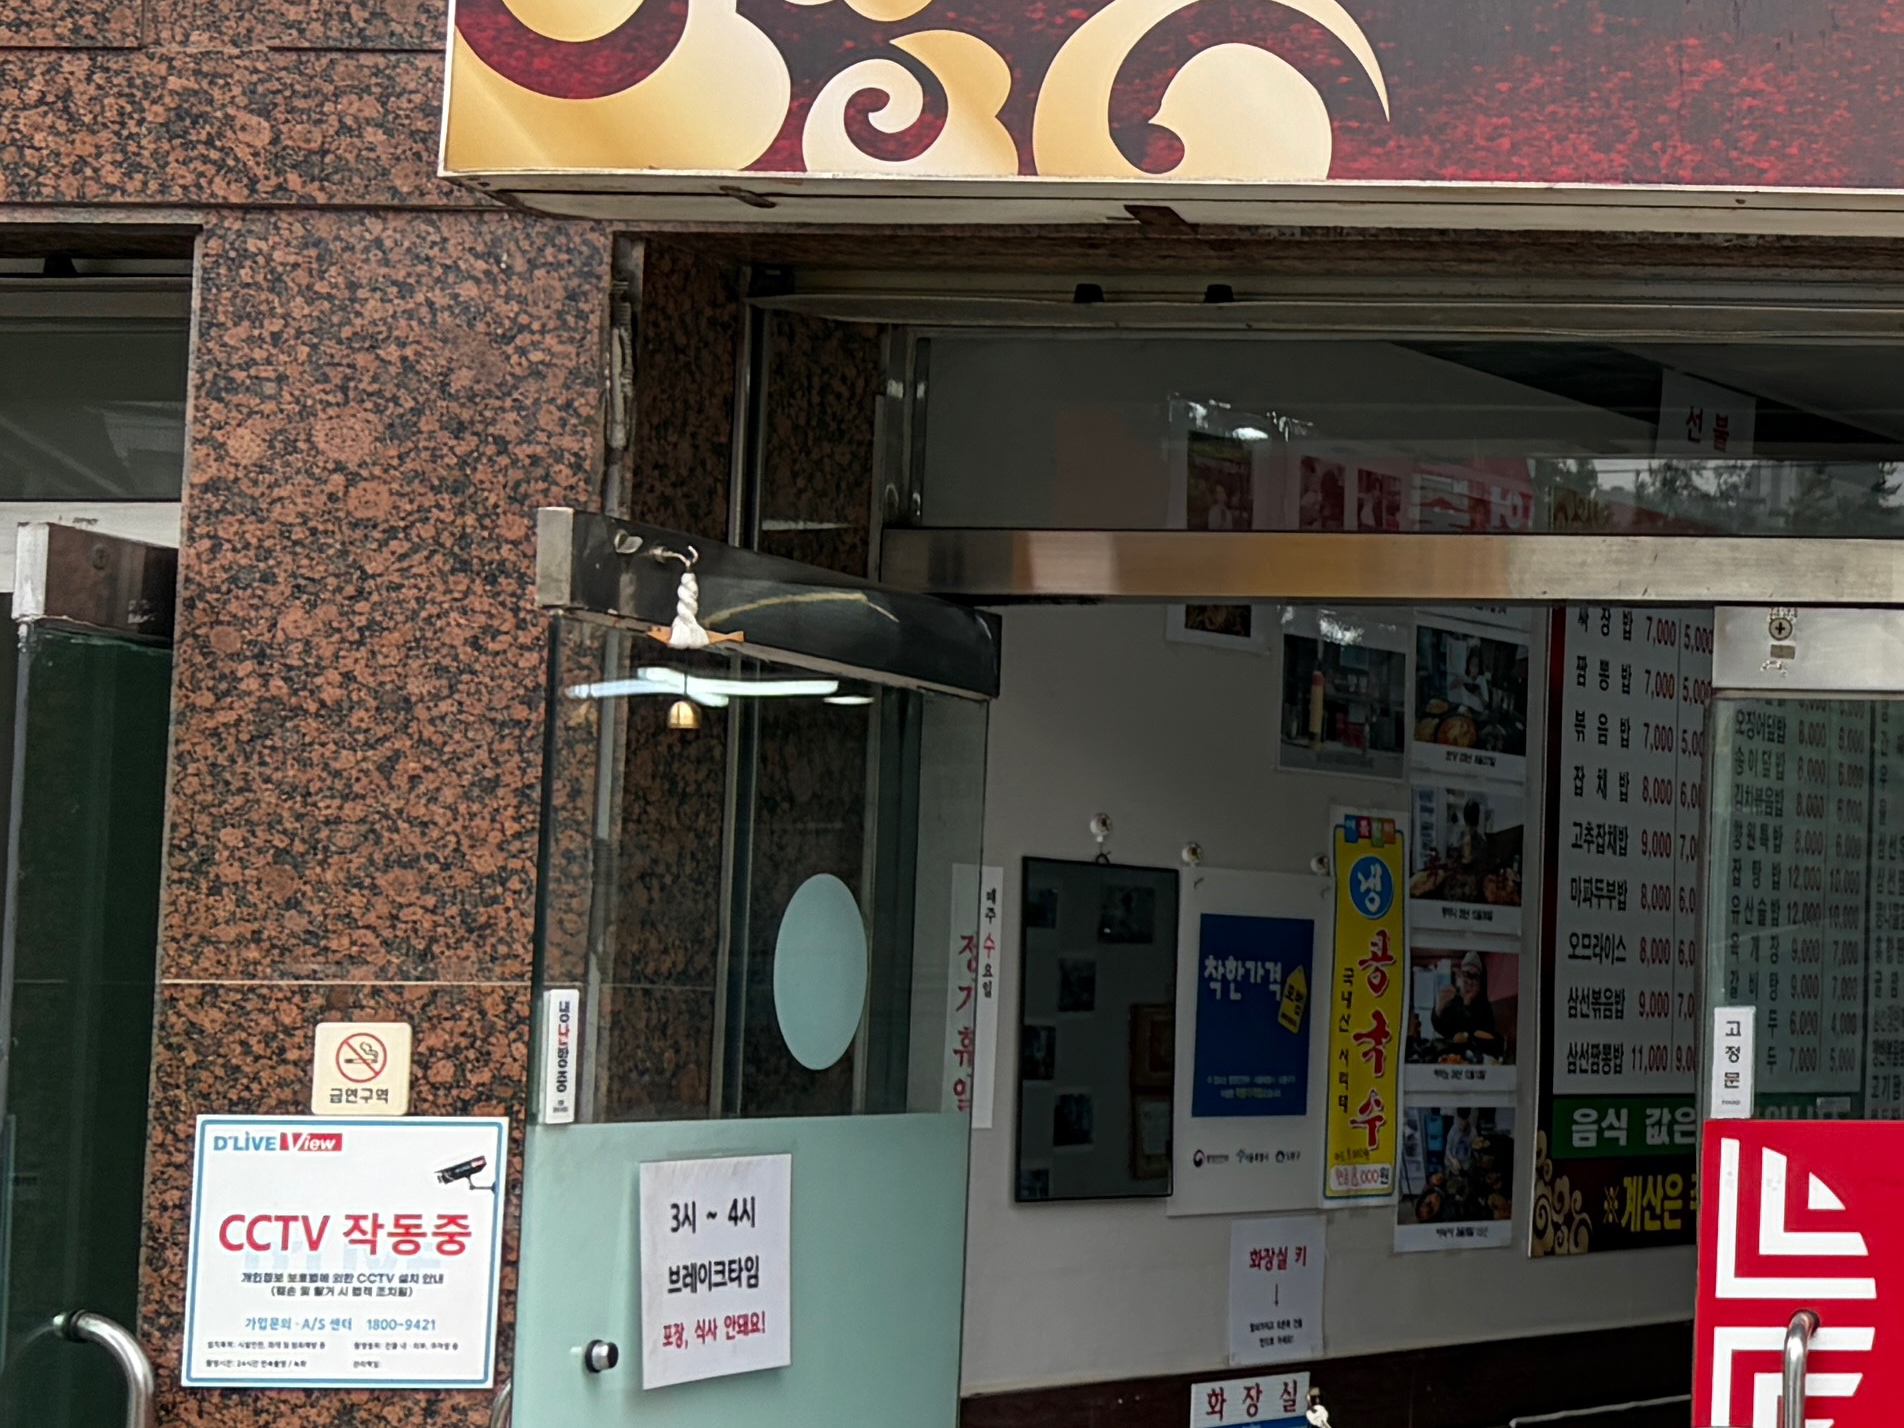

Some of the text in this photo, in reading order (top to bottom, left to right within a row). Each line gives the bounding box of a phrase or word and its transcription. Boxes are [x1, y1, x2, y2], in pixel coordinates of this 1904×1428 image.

[1646, 616, 1677, 647] 7,000
[1644, 670, 1675, 700] 7,000
[1643, 722, 1674, 753] 7,000
[1642, 775, 1673, 806] 8,000
[1571, 821, 1672, 860] 고추잡채밥 9,000
[1570, 875, 1671, 913] 마파두부밥 8,000
[1568, 931, 1671, 967] 오므라이스 8,000
[1203, 954, 1283, 1002] 착한가격
[1567, 986, 1670, 1021] 삼선볶음밥 9,000
[1566, 1041, 1669, 1076] 삼선짬뽕밥 11,000
[1724, 1020, 1741, 1089] 고정문
[329, 1087, 389, 1104] 금연구역
[1571, 1106, 1697, 1148] 음식 값은
[670, 1200, 697, 1234] 3시
[727, 1195, 756, 1228] 4시
[218, 1212, 472, 1256] CCTV 작동중
[667, 1255, 760, 1294] 브레이크타임
[1249, 1245, 1307, 1272] 화장실 키
[356, 1273, 395, 1285] CCTV
[244, 1317, 437, 1332] 가입문의 A/S 센터 1800-9421
[694, 1317, 718, 1345] 식사
[1205, 1379, 1299, 1421] 화장실
